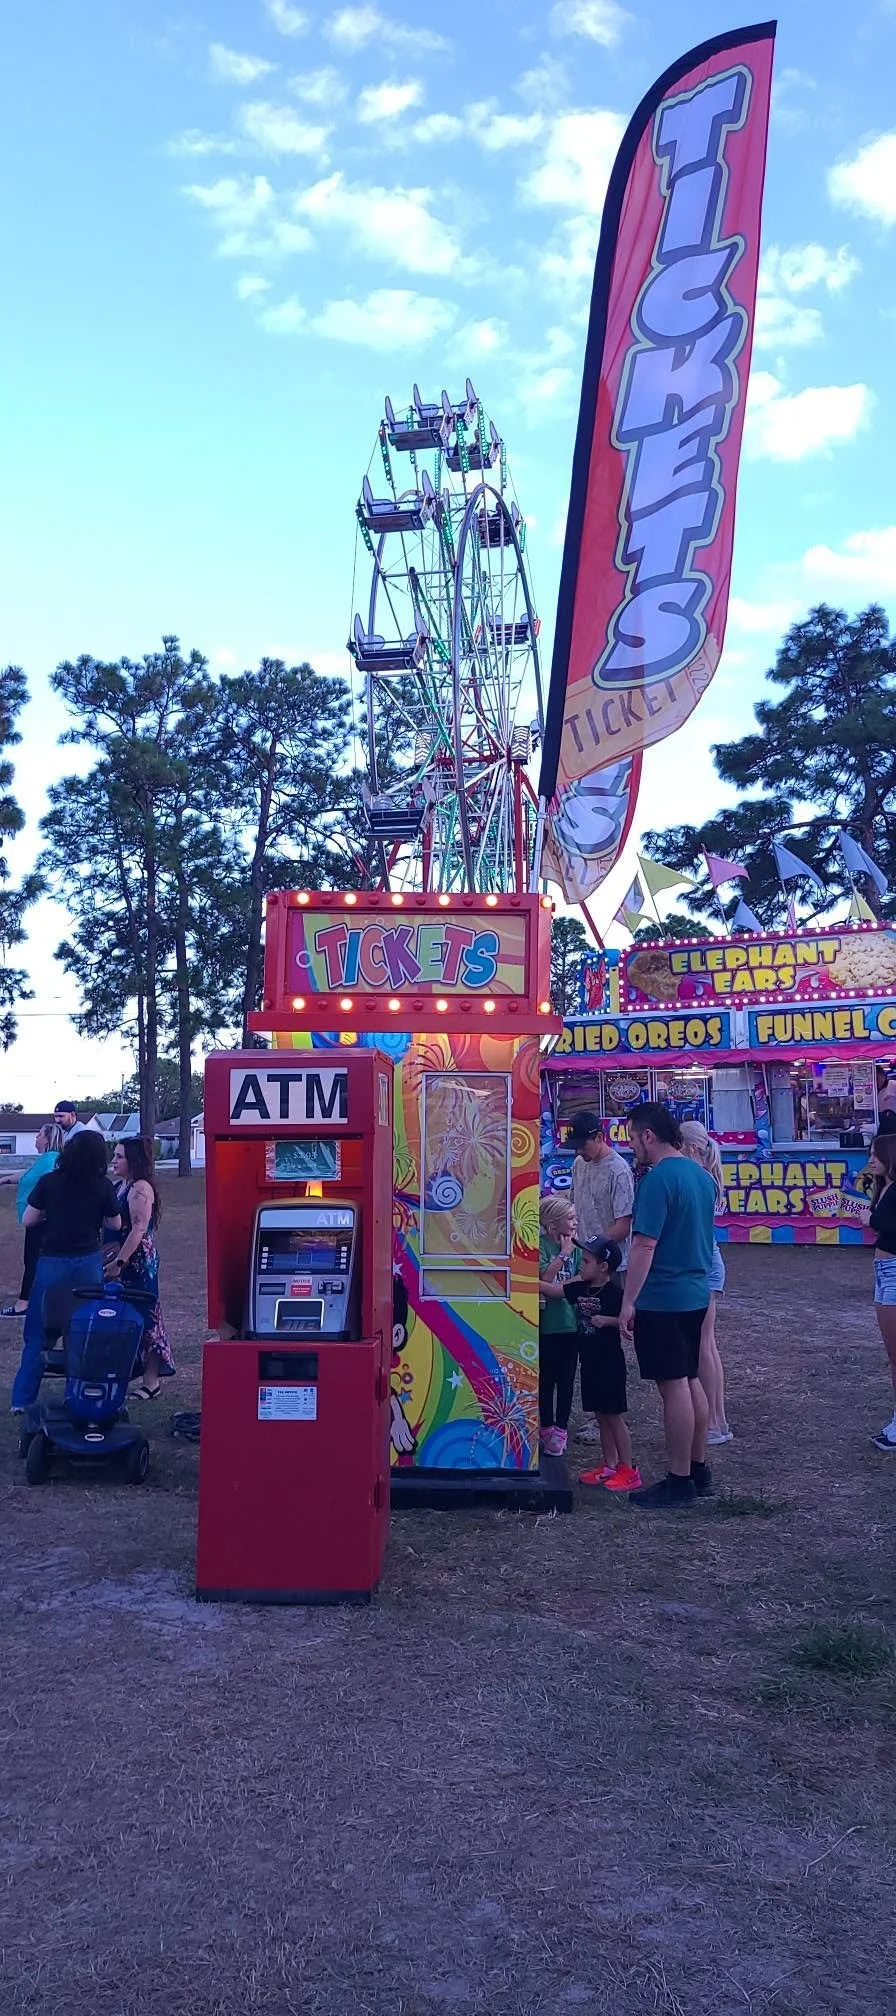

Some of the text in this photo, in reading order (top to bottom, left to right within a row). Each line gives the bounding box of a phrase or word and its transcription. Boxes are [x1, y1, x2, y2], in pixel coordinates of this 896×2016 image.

[598, 70, 746, 685] TICKETS
[313, 922, 500, 990] TICKETS
[670, 939, 840, 974] ELEPHANT
[712, 965, 796, 994] EARS
[627, 1016, 722, 1050] OREOS
[756, 1008, 870, 1043] FUNNEL
[230, 1072, 348, 1120] ATM
[727, 1188, 804, 1214] EARS
[811, 1193, 839, 1206] SLUSH
[316, 1211, 350, 1225] ATM
